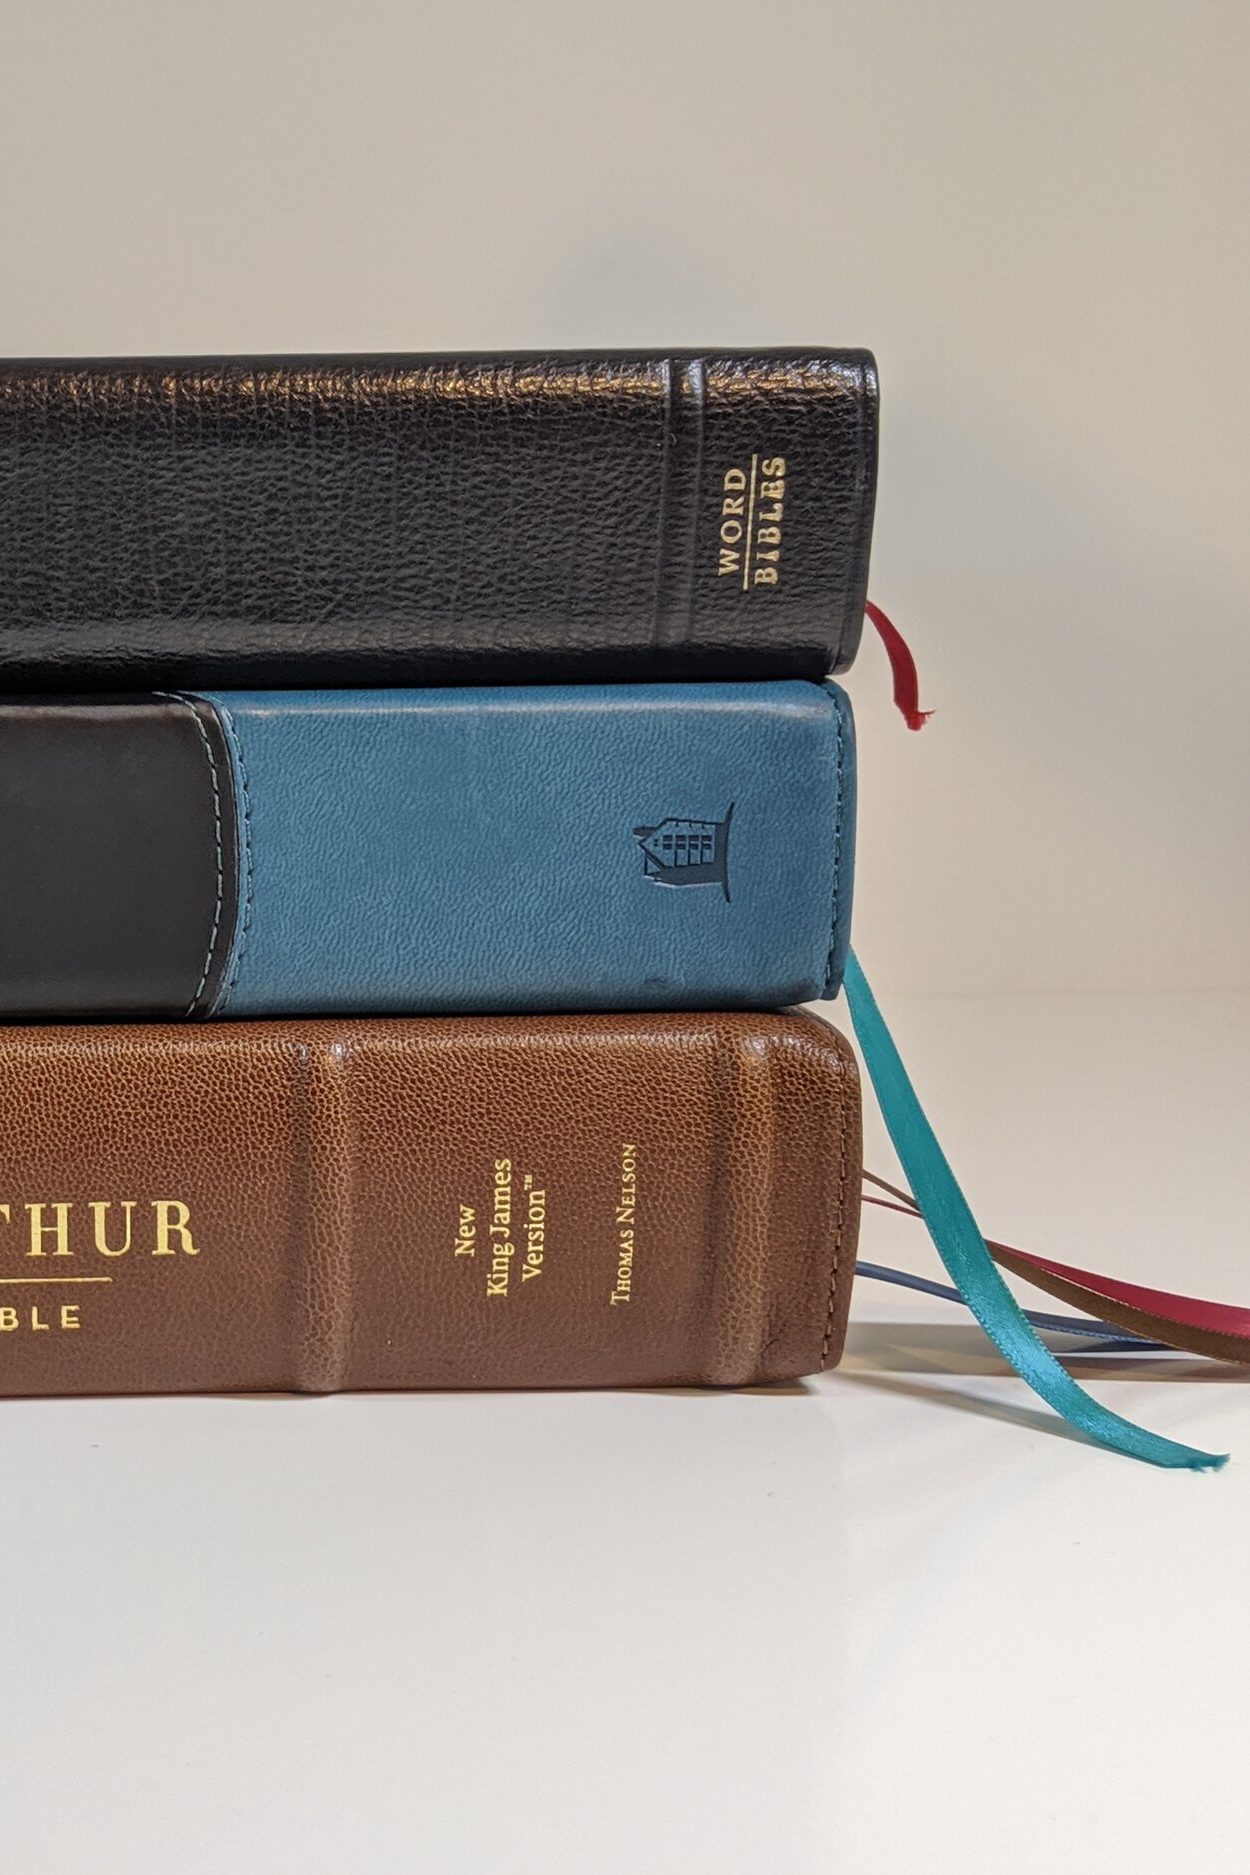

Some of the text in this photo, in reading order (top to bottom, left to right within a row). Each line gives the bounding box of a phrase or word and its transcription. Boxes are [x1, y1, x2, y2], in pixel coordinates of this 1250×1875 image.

[718, 468, 746, 576] WORD
[754, 457, 786, 584] BIBLES
[455, 1203, 476, 1257] New
[487, 1158, 515, 1297] King James
